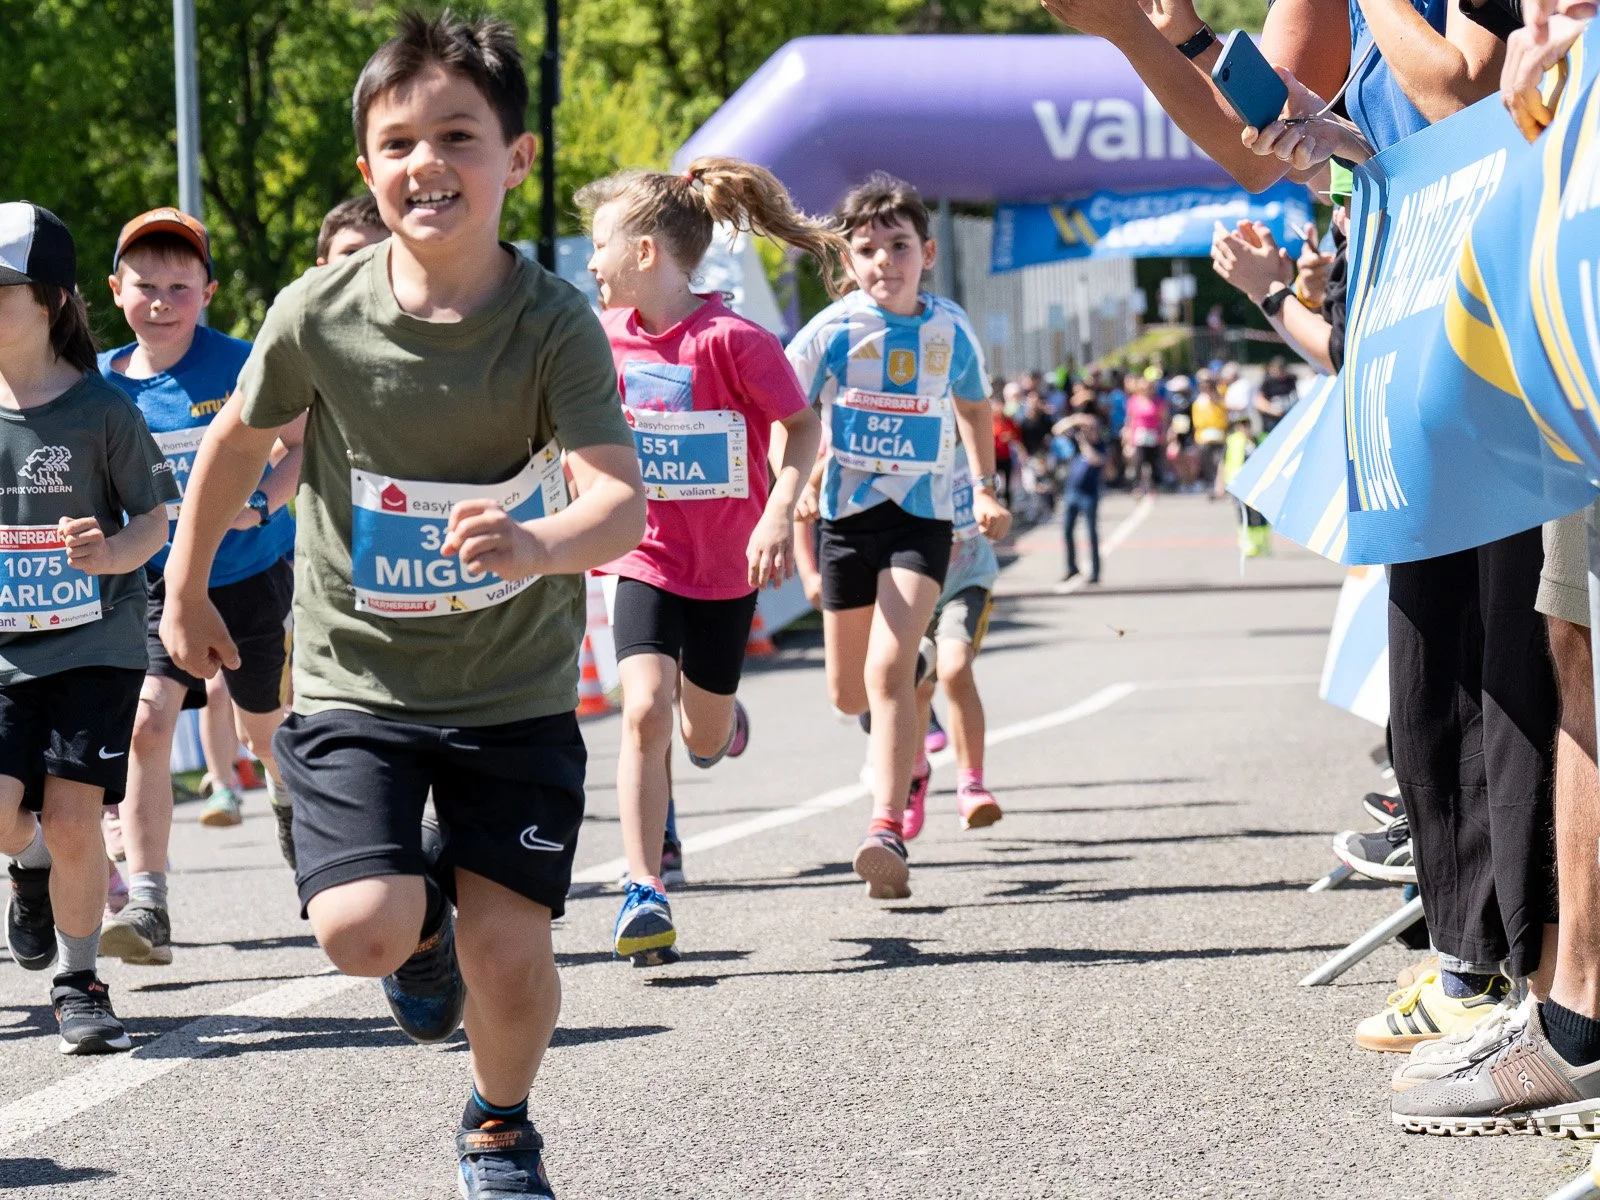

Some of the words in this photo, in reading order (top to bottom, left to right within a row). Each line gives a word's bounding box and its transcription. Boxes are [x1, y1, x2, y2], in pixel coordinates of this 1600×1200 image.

[637, 421, 706, 432] easyhomes.ch
[867, 414, 904, 434] 847
[641, 436, 679, 457] 551
[849, 433, 917, 459] LUCÍA
[6, 486, 26, 495] PRIX
[26, 486, 46, 494] VON
[48, 485, 73, 493] BERN
[680, 487, 717, 497] valiant
[420, 524, 450, 551] 3
[4, 555, 63, 578] 1075
[375, 555, 500, 589] MIGU
